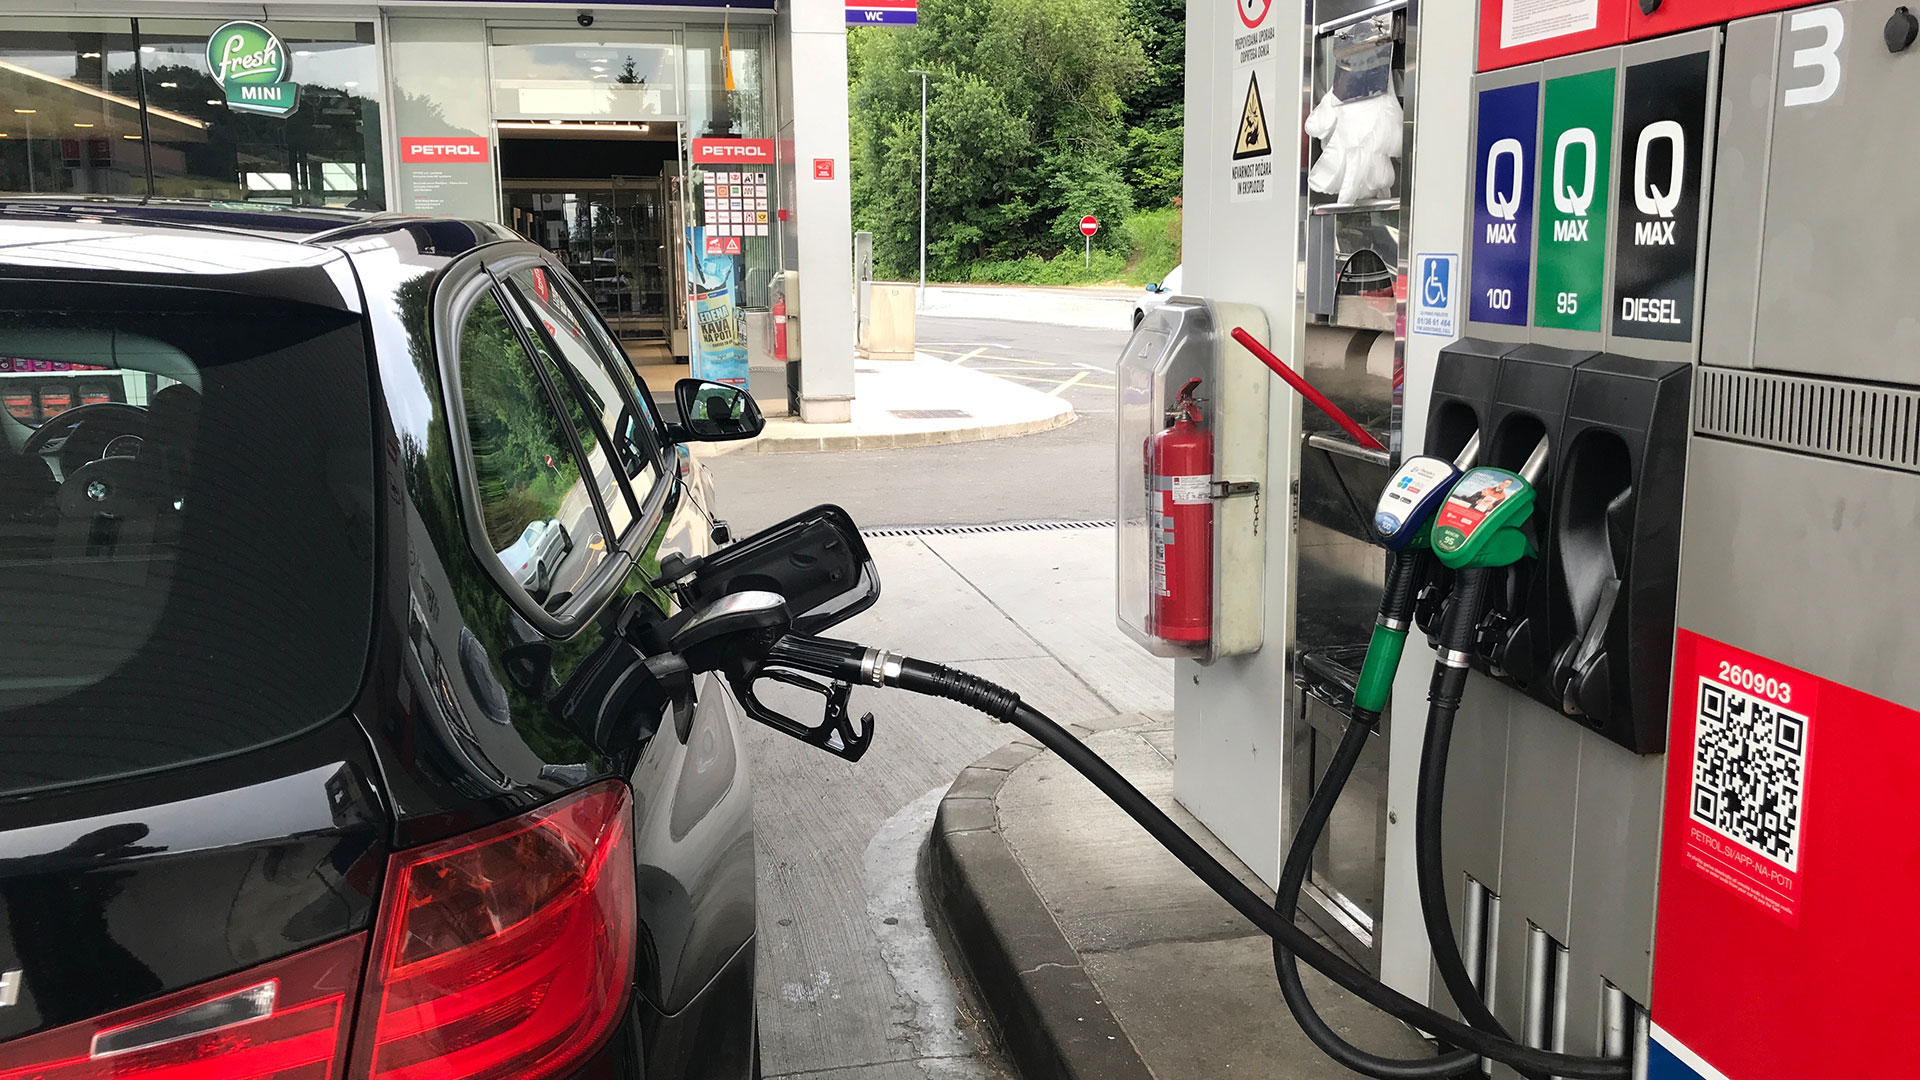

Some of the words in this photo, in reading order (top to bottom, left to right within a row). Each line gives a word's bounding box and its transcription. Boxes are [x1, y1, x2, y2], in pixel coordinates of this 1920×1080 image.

[865, 12, 883, 21] WC
[219, 35, 277, 83] fresh
[1784, 9, 1844, 107] 3
[242, 86, 281, 100] MINI
[411, 145, 480, 155] PETROL
[702, 146, 766, 156] PETROL
[1486, 138, 1523, 220] Q
[1553, 127, 1596, 218] Q
[1634, 120, 1685, 218] Q
[1486, 222, 1516, 244] MAX
[1553, 220, 1589, 242] MAX
[1634, 221, 1676, 246] MAX
[1486, 288, 1511, 310] 100
[1557, 292, 1578, 314] 95
[1622, 297, 1681, 324] DIESEL
[701, 319, 729, 334] KAVA
[703, 334, 713, 342] NA
[715, 331, 732, 342] POTI
[1444, 536, 1454, 545] 95
[1718, 660, 1791, 704] 260903
[1690, 827, 1792, 890] PETROL.SI/APP-NA-POTI
